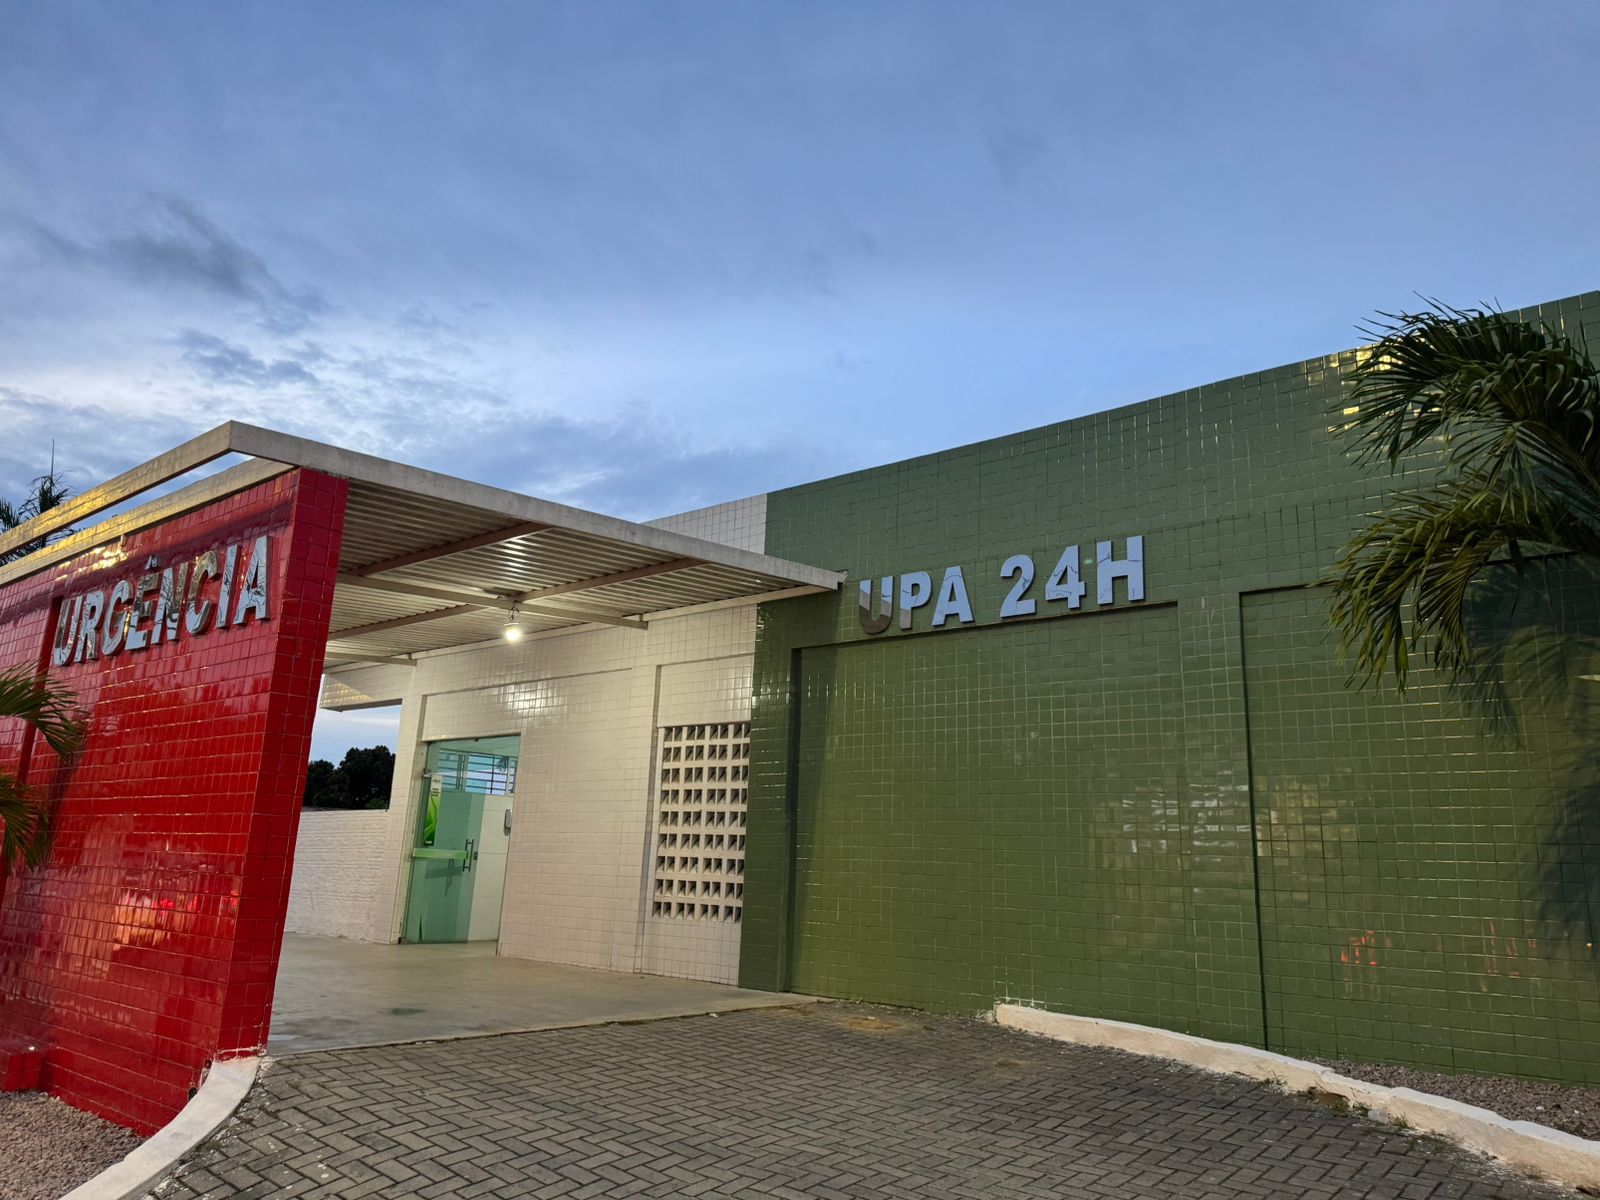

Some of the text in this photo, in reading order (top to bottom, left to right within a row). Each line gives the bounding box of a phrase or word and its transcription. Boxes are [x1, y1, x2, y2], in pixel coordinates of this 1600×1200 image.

[53, 535, 271, 666] URGÊNCIA
[859, 535, 1145, 633] UPA 24H
